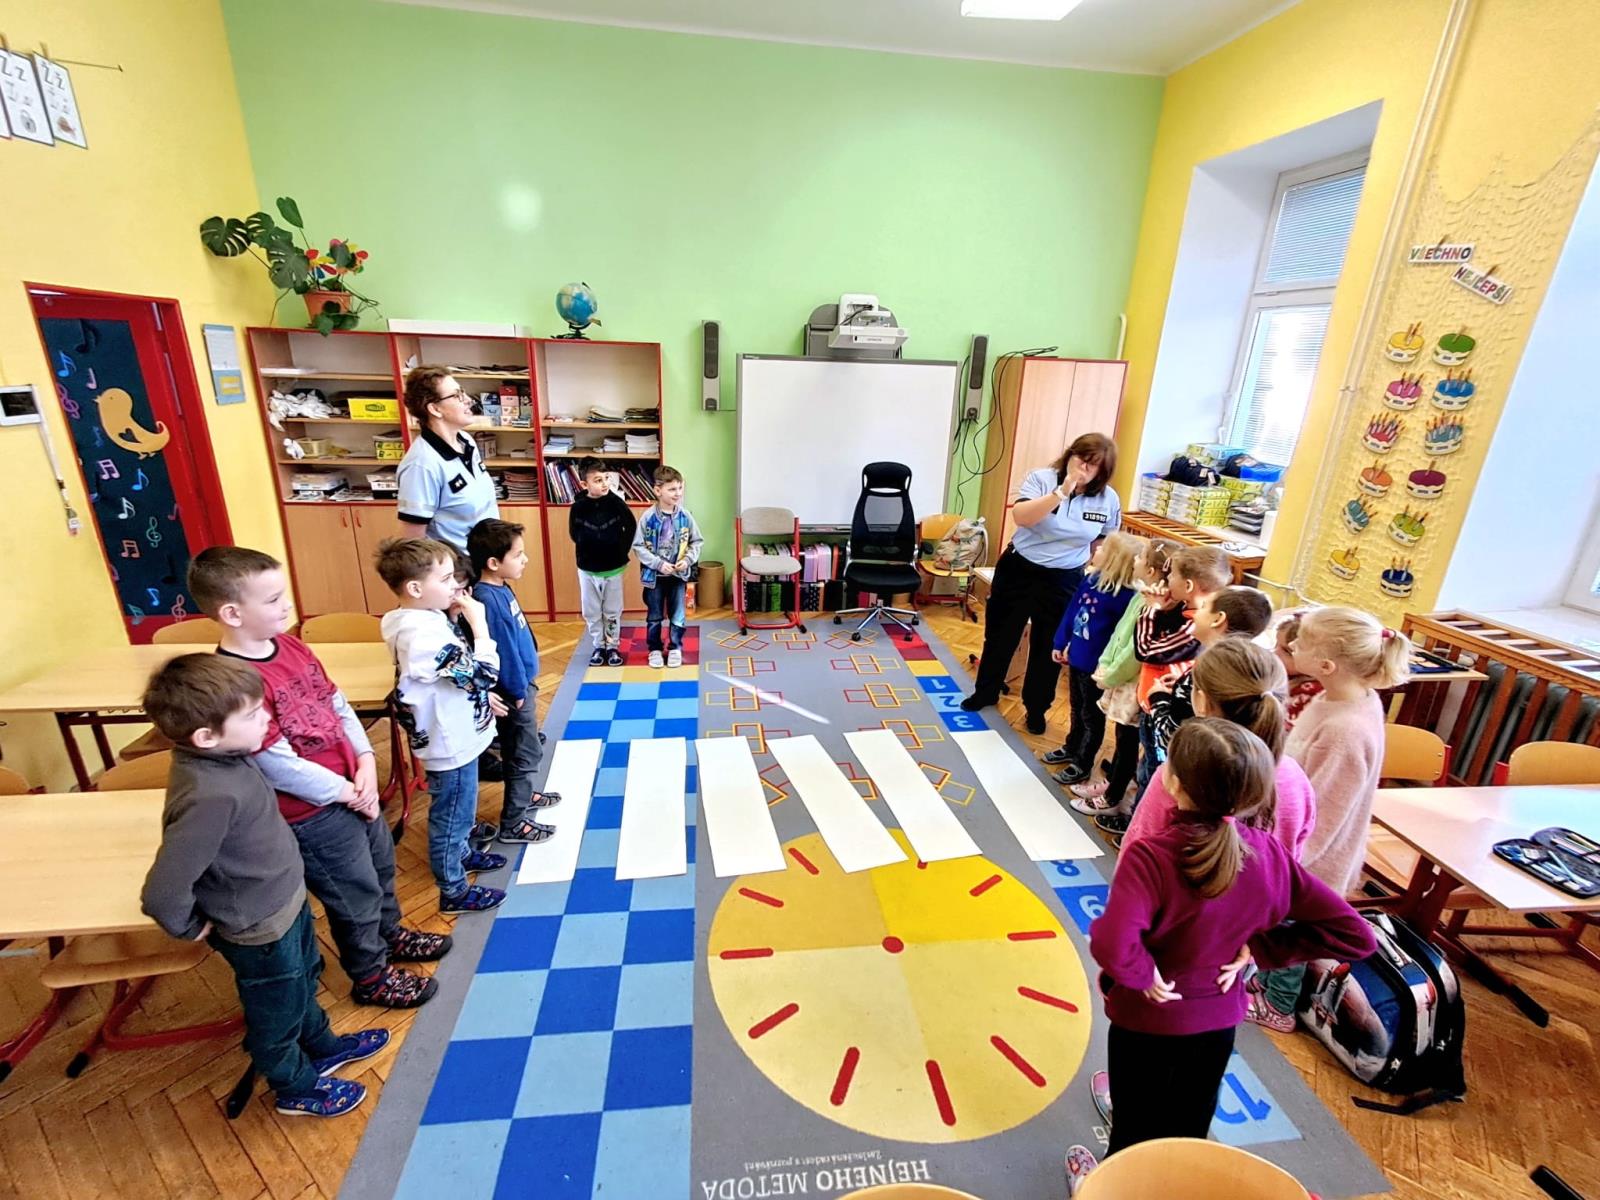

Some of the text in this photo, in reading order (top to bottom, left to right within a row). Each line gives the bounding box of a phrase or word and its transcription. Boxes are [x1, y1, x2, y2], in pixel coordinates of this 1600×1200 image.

[939, 695, 960, 708] 2
[953, 715, 974, 728] 3
[701, 1171, 808, 1200] METODA
